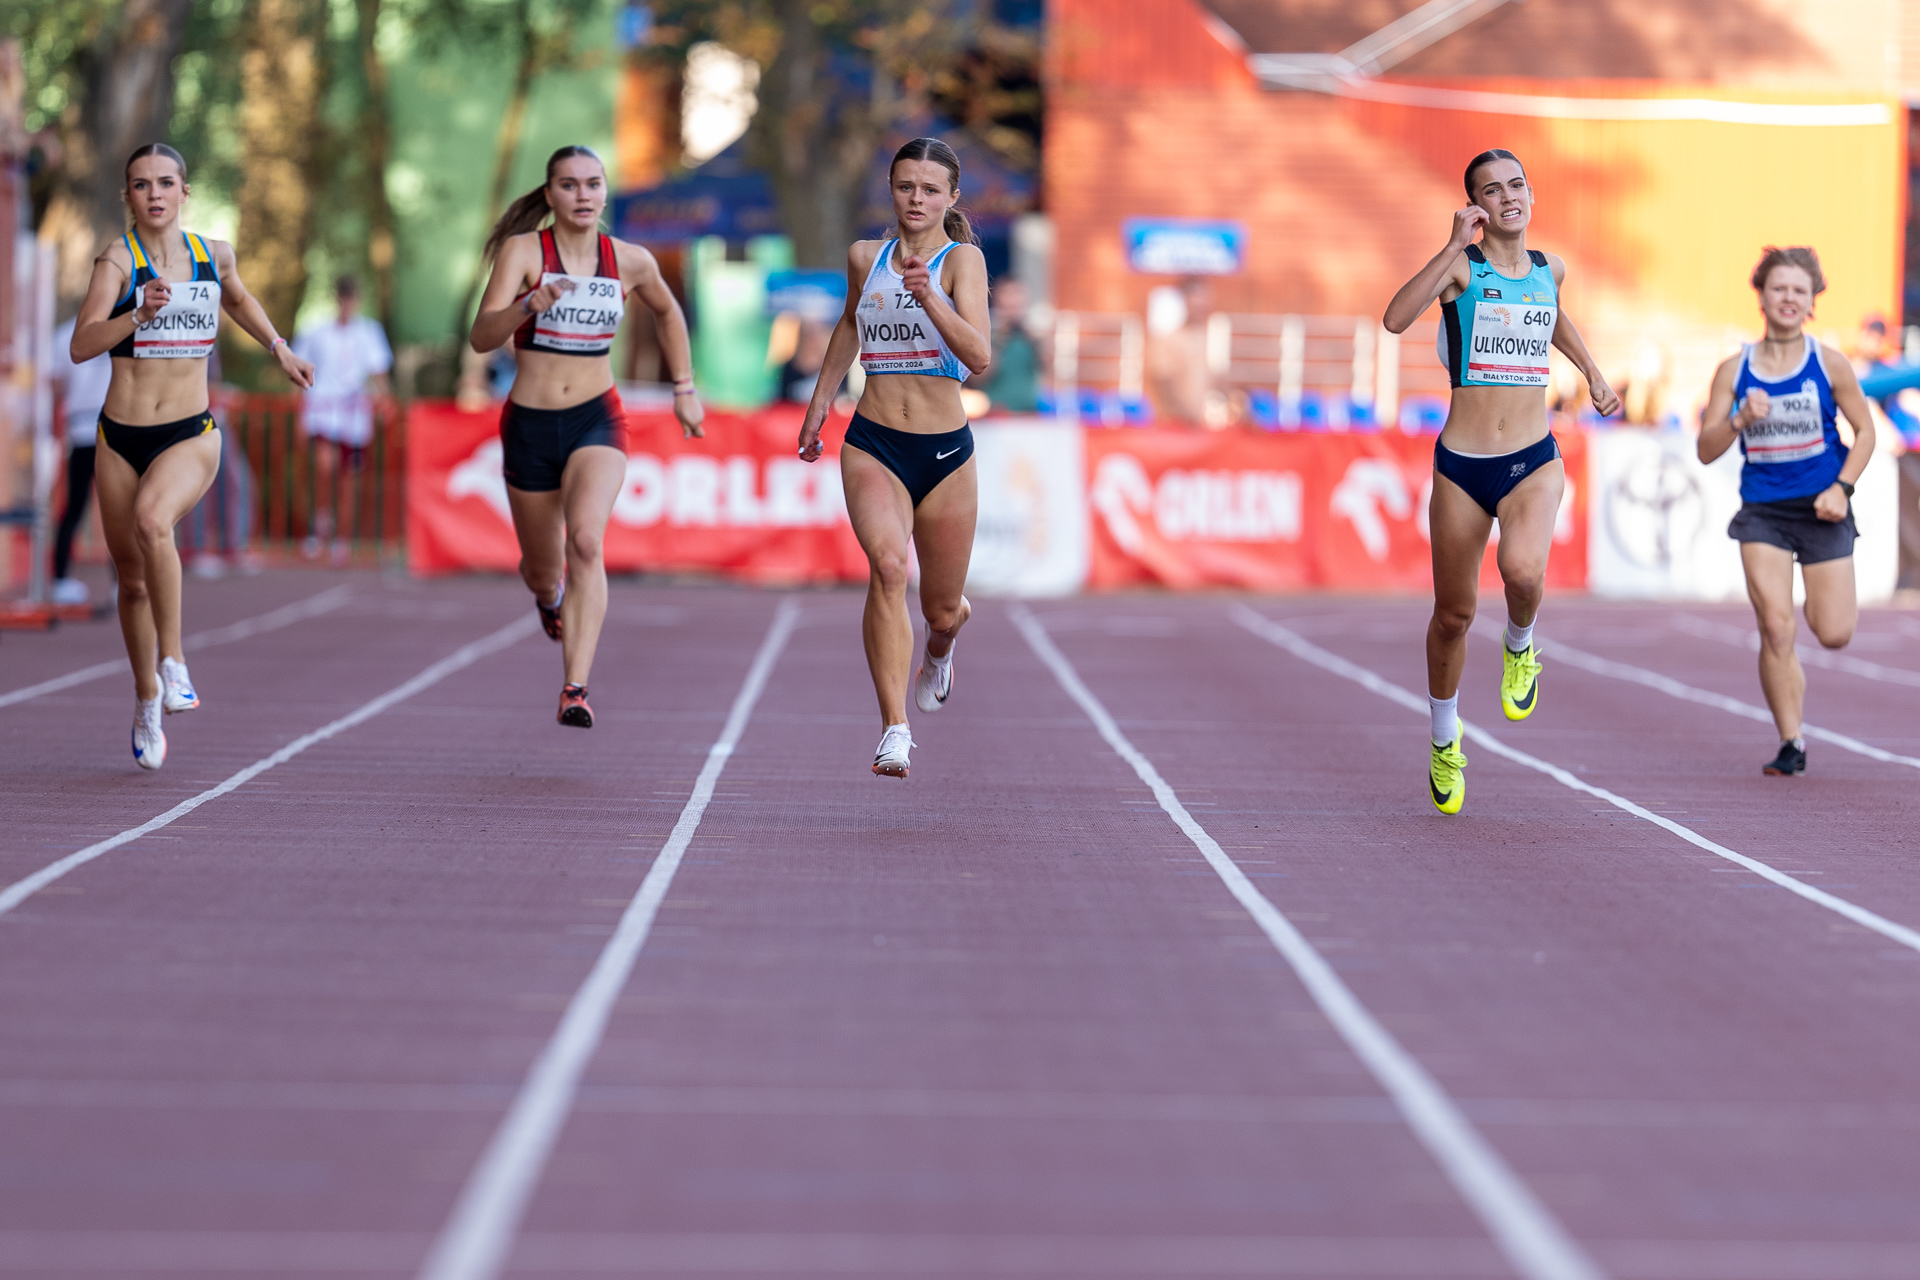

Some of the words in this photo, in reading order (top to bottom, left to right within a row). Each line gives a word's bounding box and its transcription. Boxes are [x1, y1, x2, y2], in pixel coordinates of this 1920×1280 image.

[189, 286, 210, 301] 74
[589, 282, 616, 298] 930
[542, 306, 618, 326] ANTCZAK
[1523, 310, 1551, 326] 640
[863, 322, 926, 342] WOJDA
[1474, 335, 1548, 357] ULIKOWSKA
[1483, 373, 1524, 382] BIAŁYSTOK
[1782, 398, 1811, 411] 902
